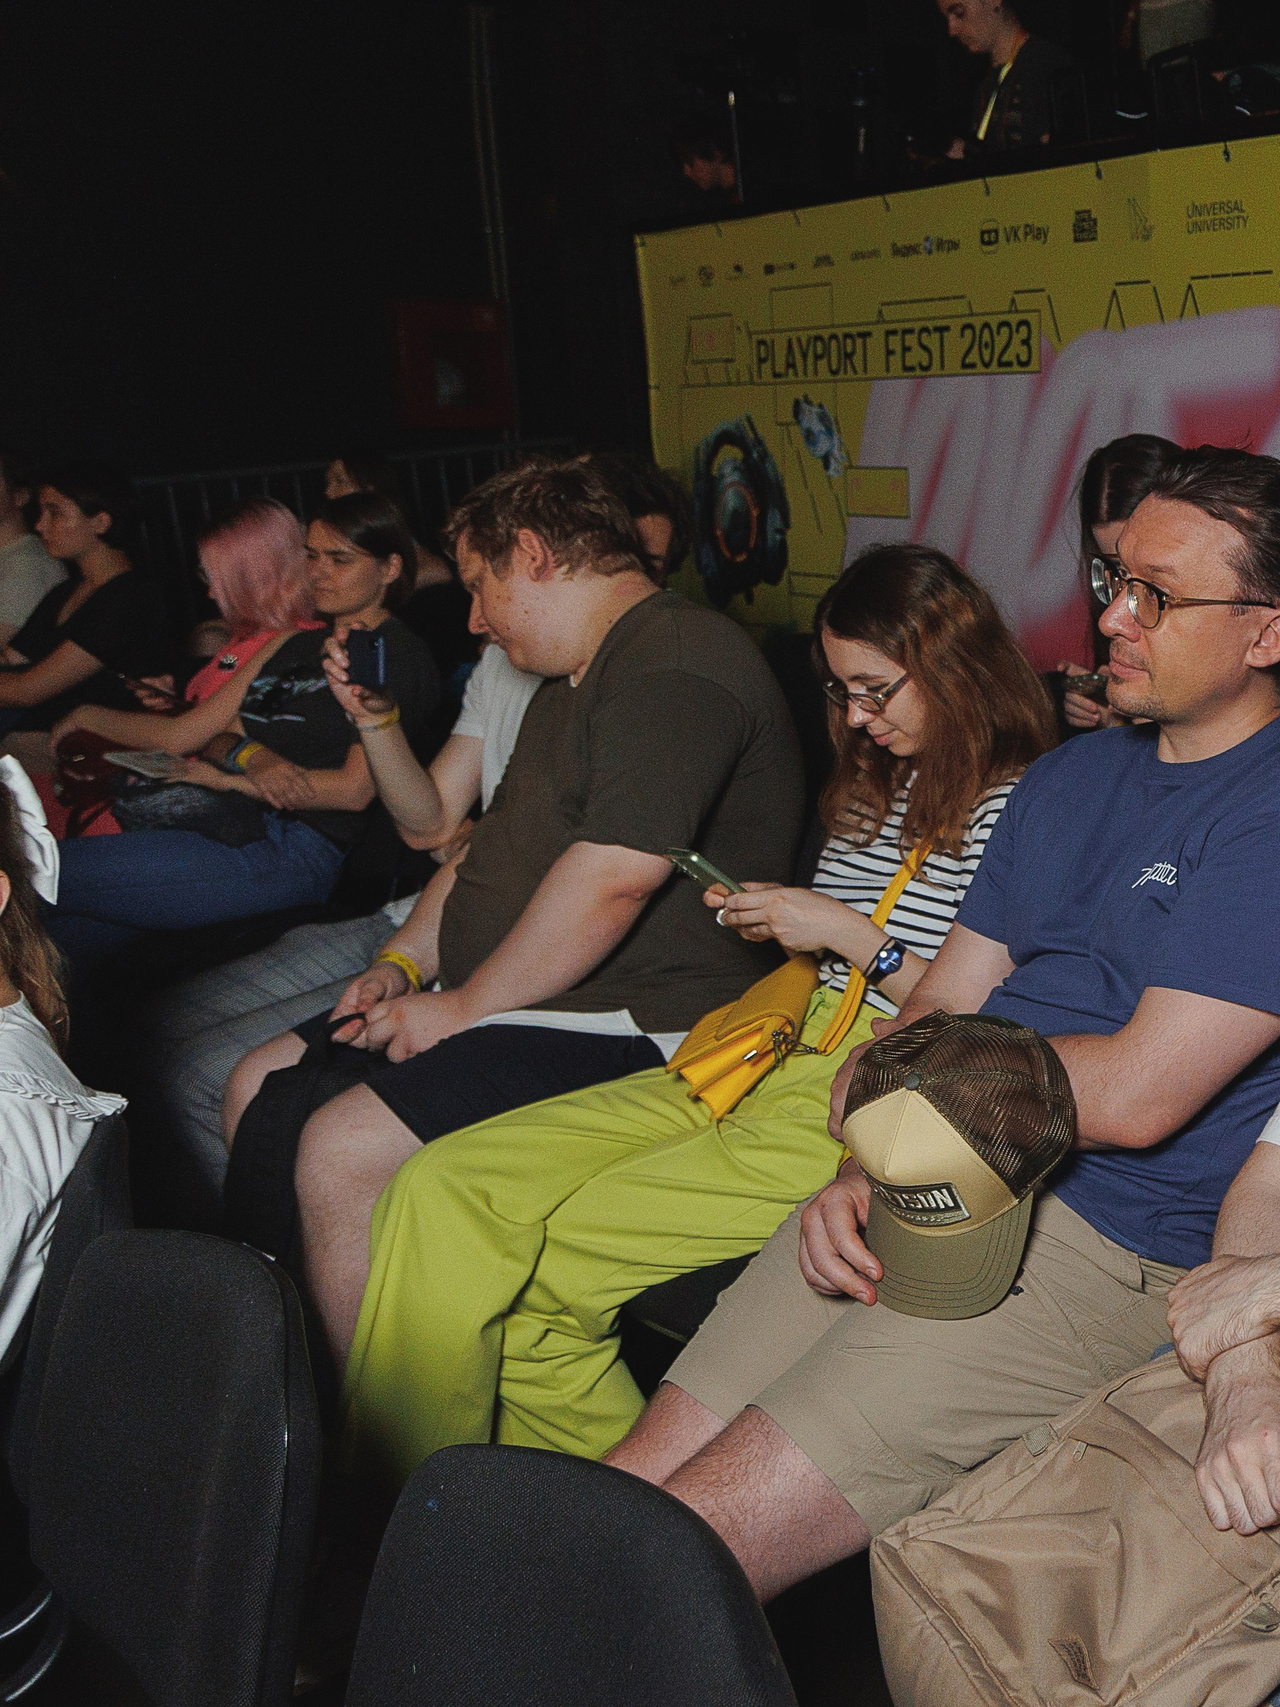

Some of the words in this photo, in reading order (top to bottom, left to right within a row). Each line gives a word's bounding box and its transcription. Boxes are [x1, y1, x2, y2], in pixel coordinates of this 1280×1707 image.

[1186, 200, 1246, 218] UNIVERSAL
[1004, 225, 1021, 243] VK
[1023, 223, 1050, 244] Play
[1186, 215, 1250, 234] UNIVERSITY
[756, 330, 872, 380] PLAYPORT
[884, 324, 951, 375] FEST
[959, 320, 1033, 370] 2023
